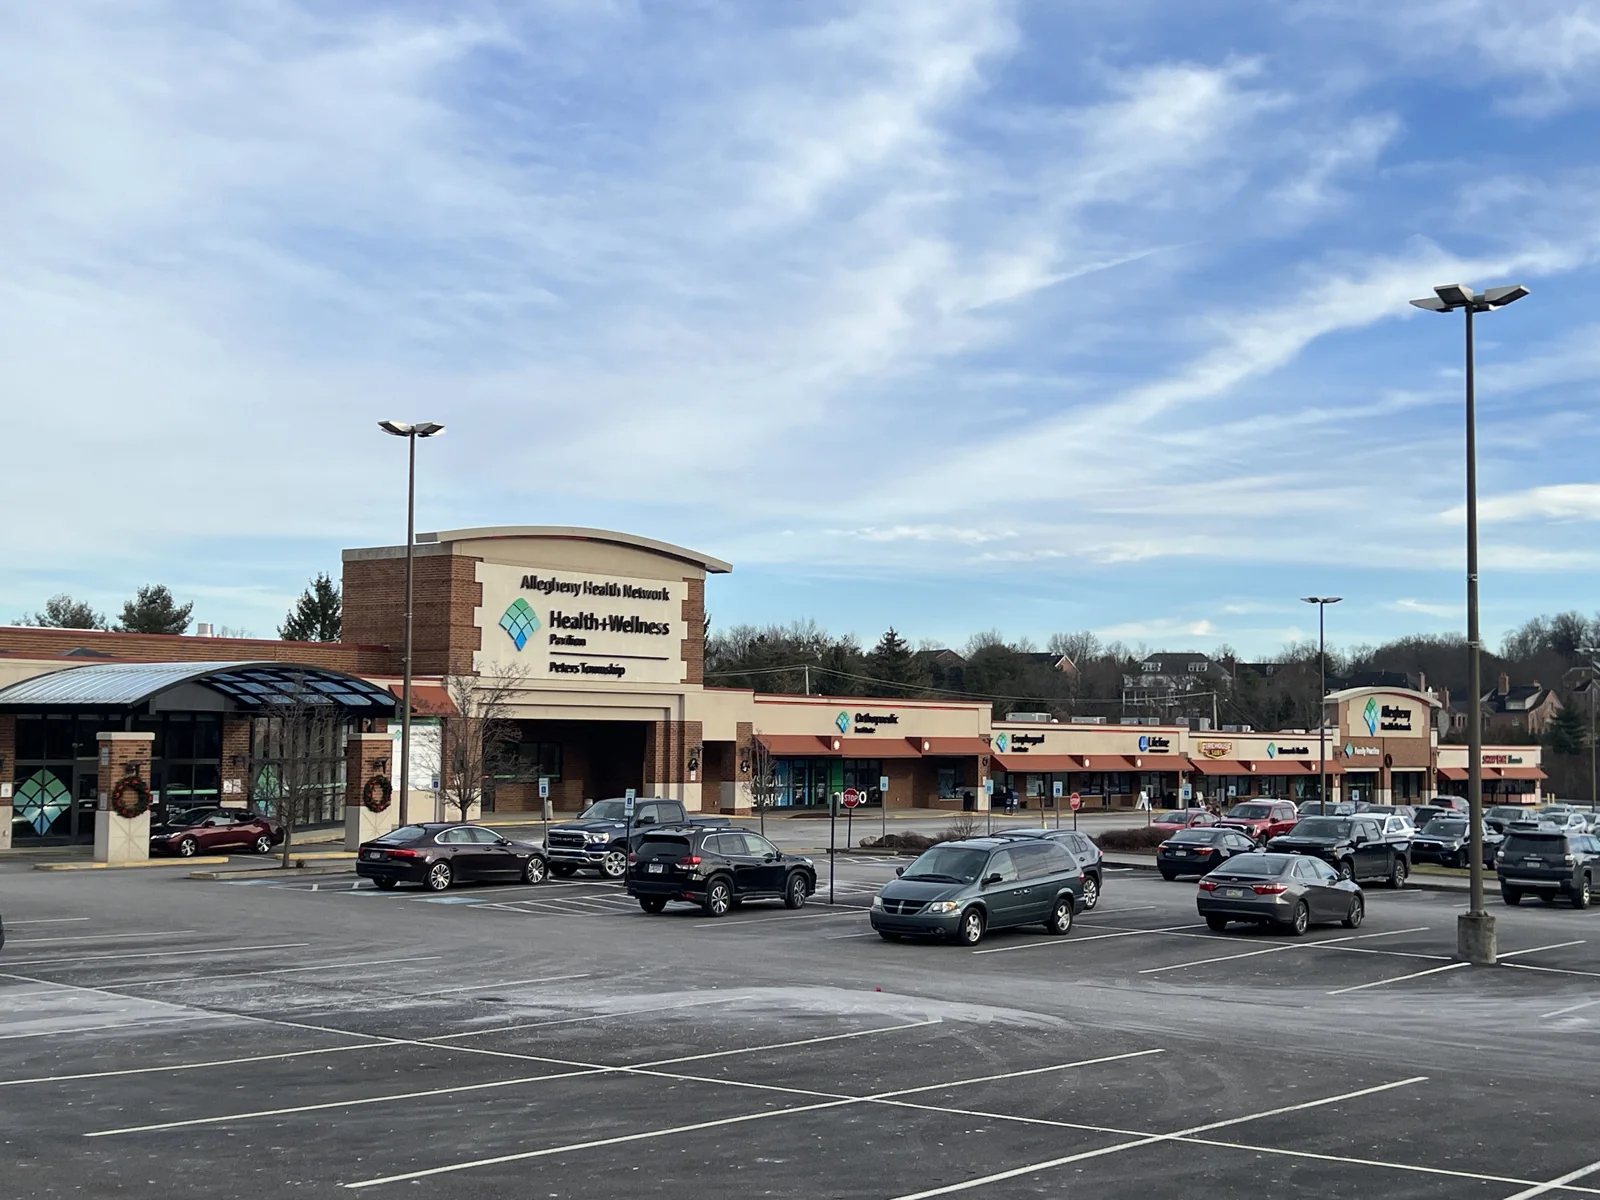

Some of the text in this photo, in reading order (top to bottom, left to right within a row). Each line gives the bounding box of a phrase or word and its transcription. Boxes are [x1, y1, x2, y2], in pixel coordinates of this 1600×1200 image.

[520, 575, 670, 601] Allegheny Health Network
[549, 610, 670, 635] Health+Wellness
[549, 633, 586, 646] Pavilion
[549, 662, 626, 678] Peters Township
[844, 794, 858, 802] STOP
